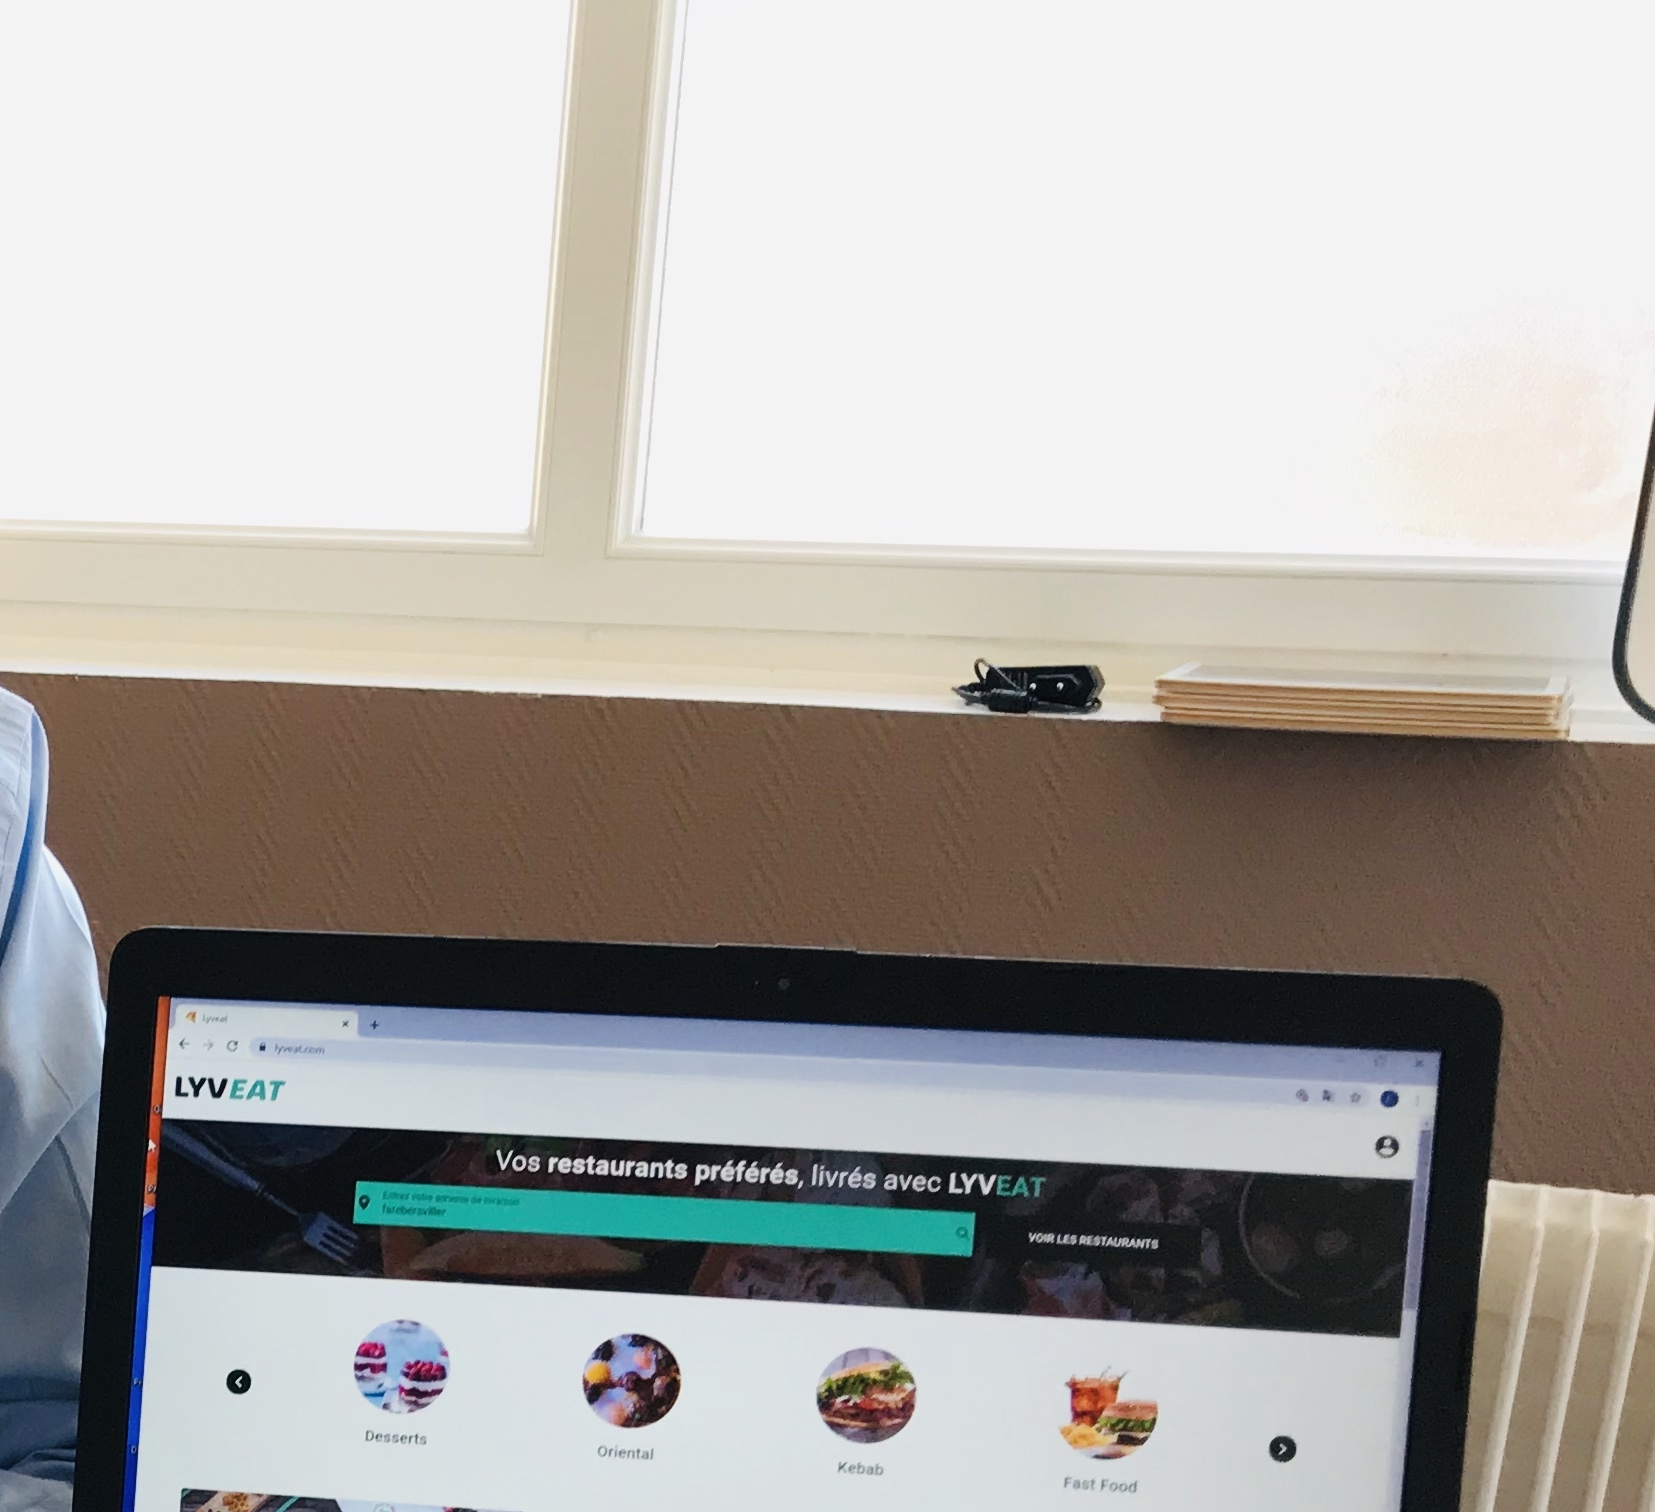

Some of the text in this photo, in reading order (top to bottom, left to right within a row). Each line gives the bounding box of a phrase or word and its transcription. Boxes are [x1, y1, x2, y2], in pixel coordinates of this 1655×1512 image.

[274, 1043, 326, 1055] lyveat.com
[174, 1076, 286, 1101] LYVEAT
[496, 1149, 1046, 1198] Vos restaurants préférés, livrés avec LYVEAT
[1028, 1231, 1159, 1250] VOIR LES RESTAURANTS
[365, 1429, 428, 1446] Desserts
[597, 1444, 655, 1460] Oriental
[837, 1461, 885, 1476] Kebab
[1063, 1476, 1138, 1494] Fast Food
